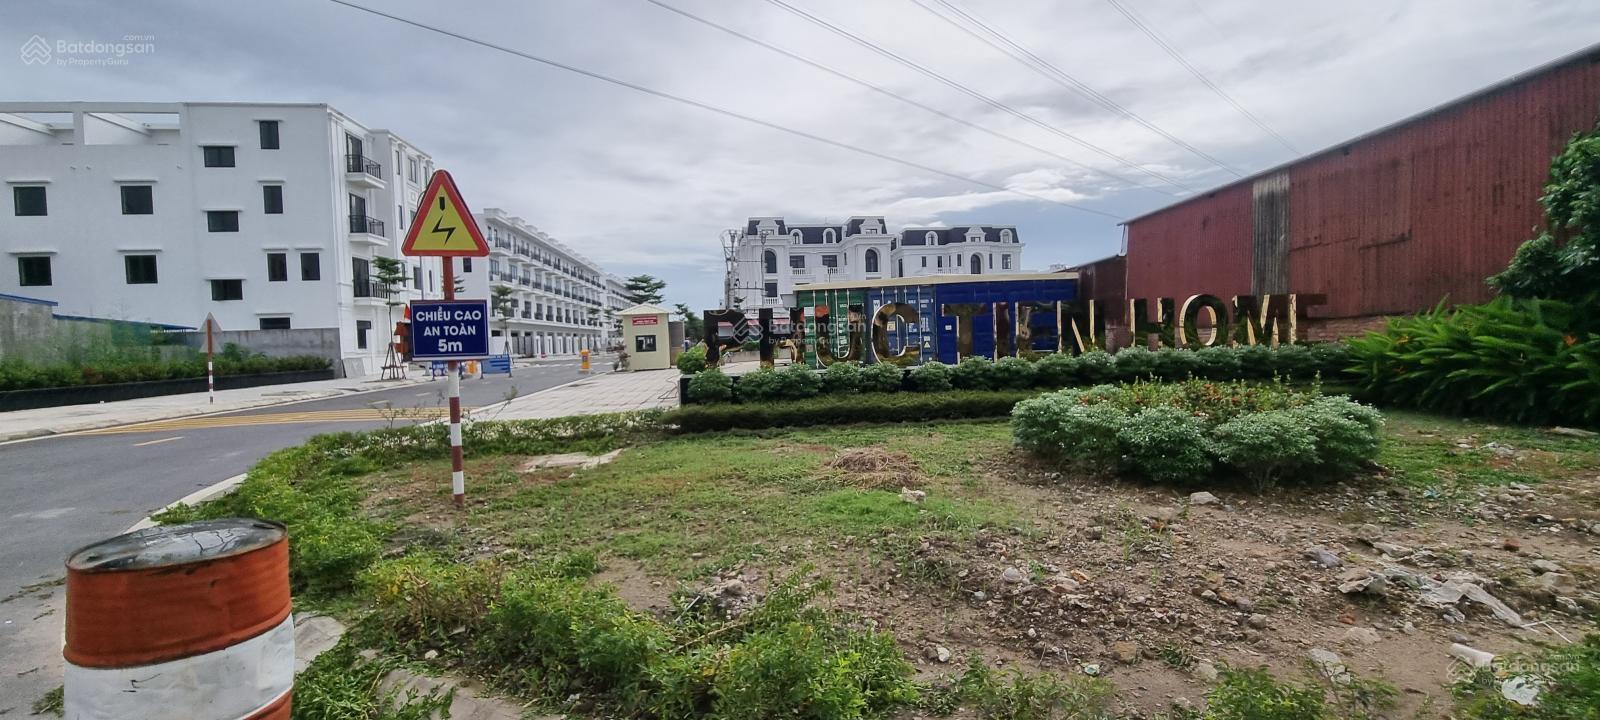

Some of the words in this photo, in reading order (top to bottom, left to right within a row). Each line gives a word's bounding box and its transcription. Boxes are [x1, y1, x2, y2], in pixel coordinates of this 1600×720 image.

[454, 311, 481, 321] CAO
[424, 326, 440, 336] AN
[443, 323, 476, 336] TOÀN
[438, 339, 463, 353] 5m
